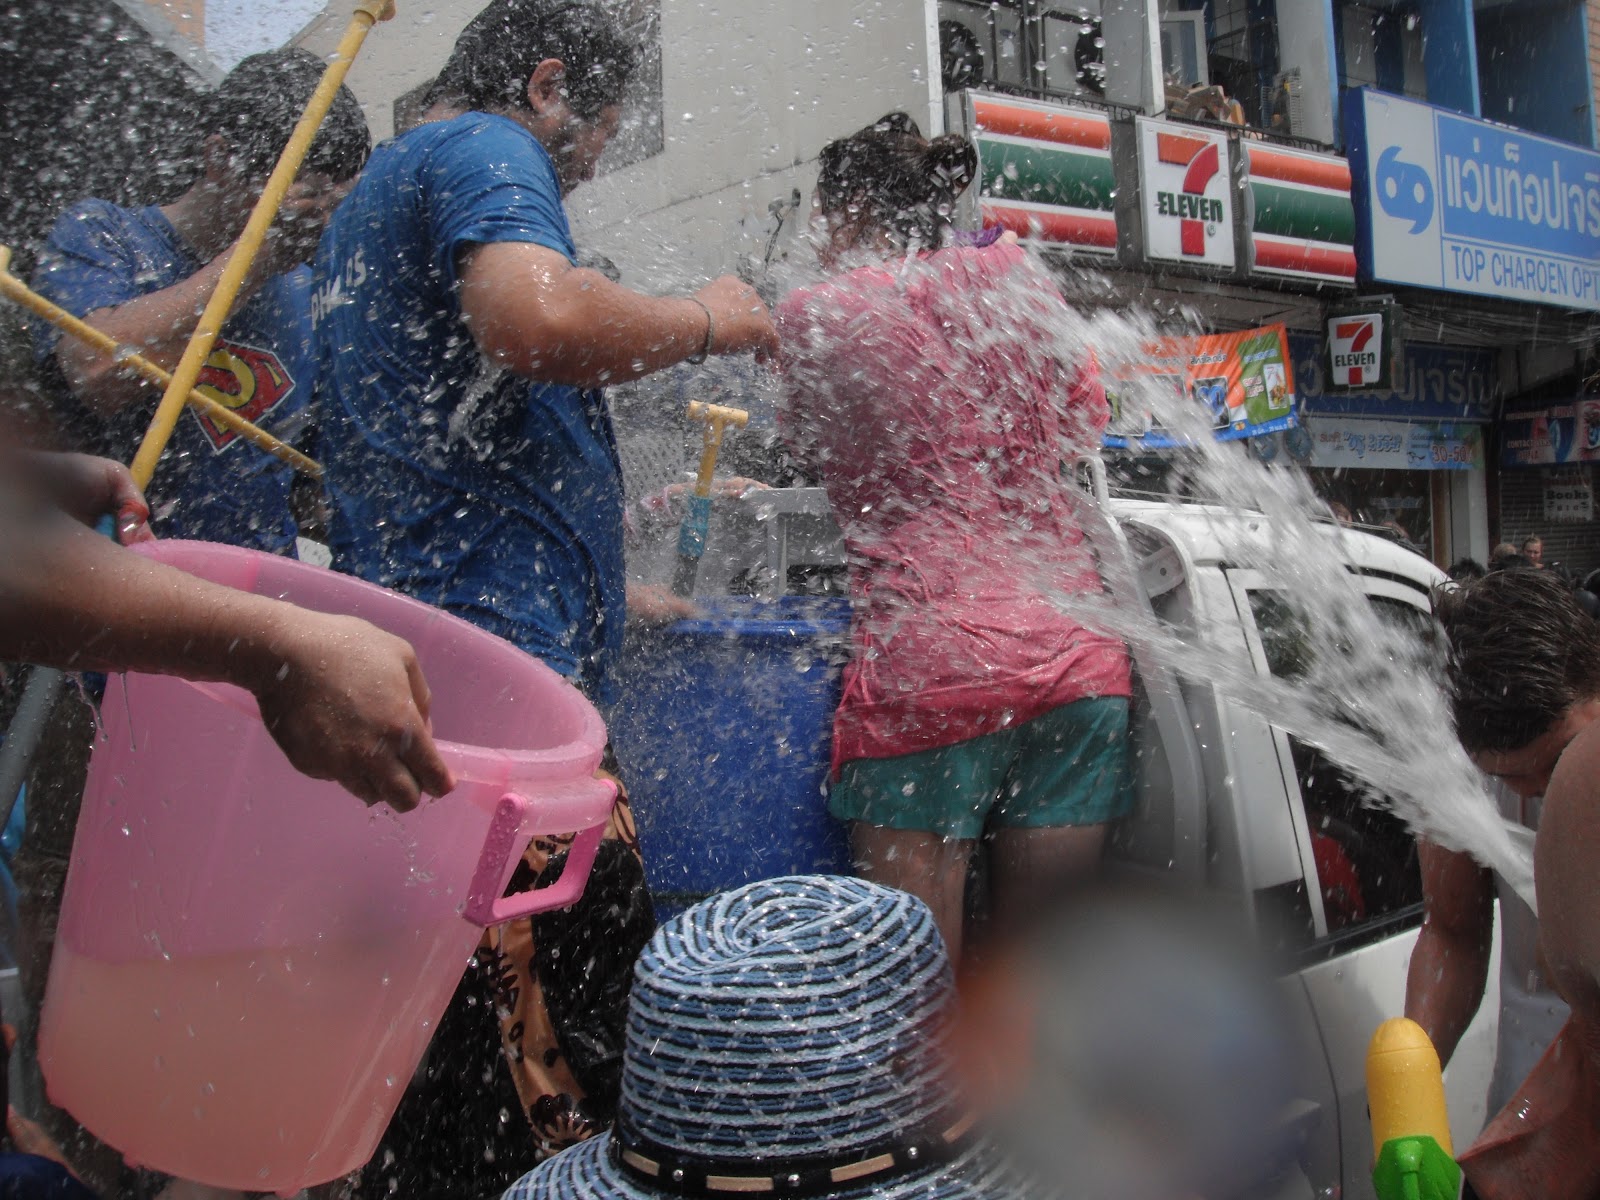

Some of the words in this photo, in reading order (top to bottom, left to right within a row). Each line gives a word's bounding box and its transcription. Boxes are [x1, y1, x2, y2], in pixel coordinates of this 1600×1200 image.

[1157, 132, 1219, 257] 7
[1451, 245, 1485, 282] TOP
[1491, 252, 1568, 296] CHAROEN
[1336, 322, 1374, 385] 7
